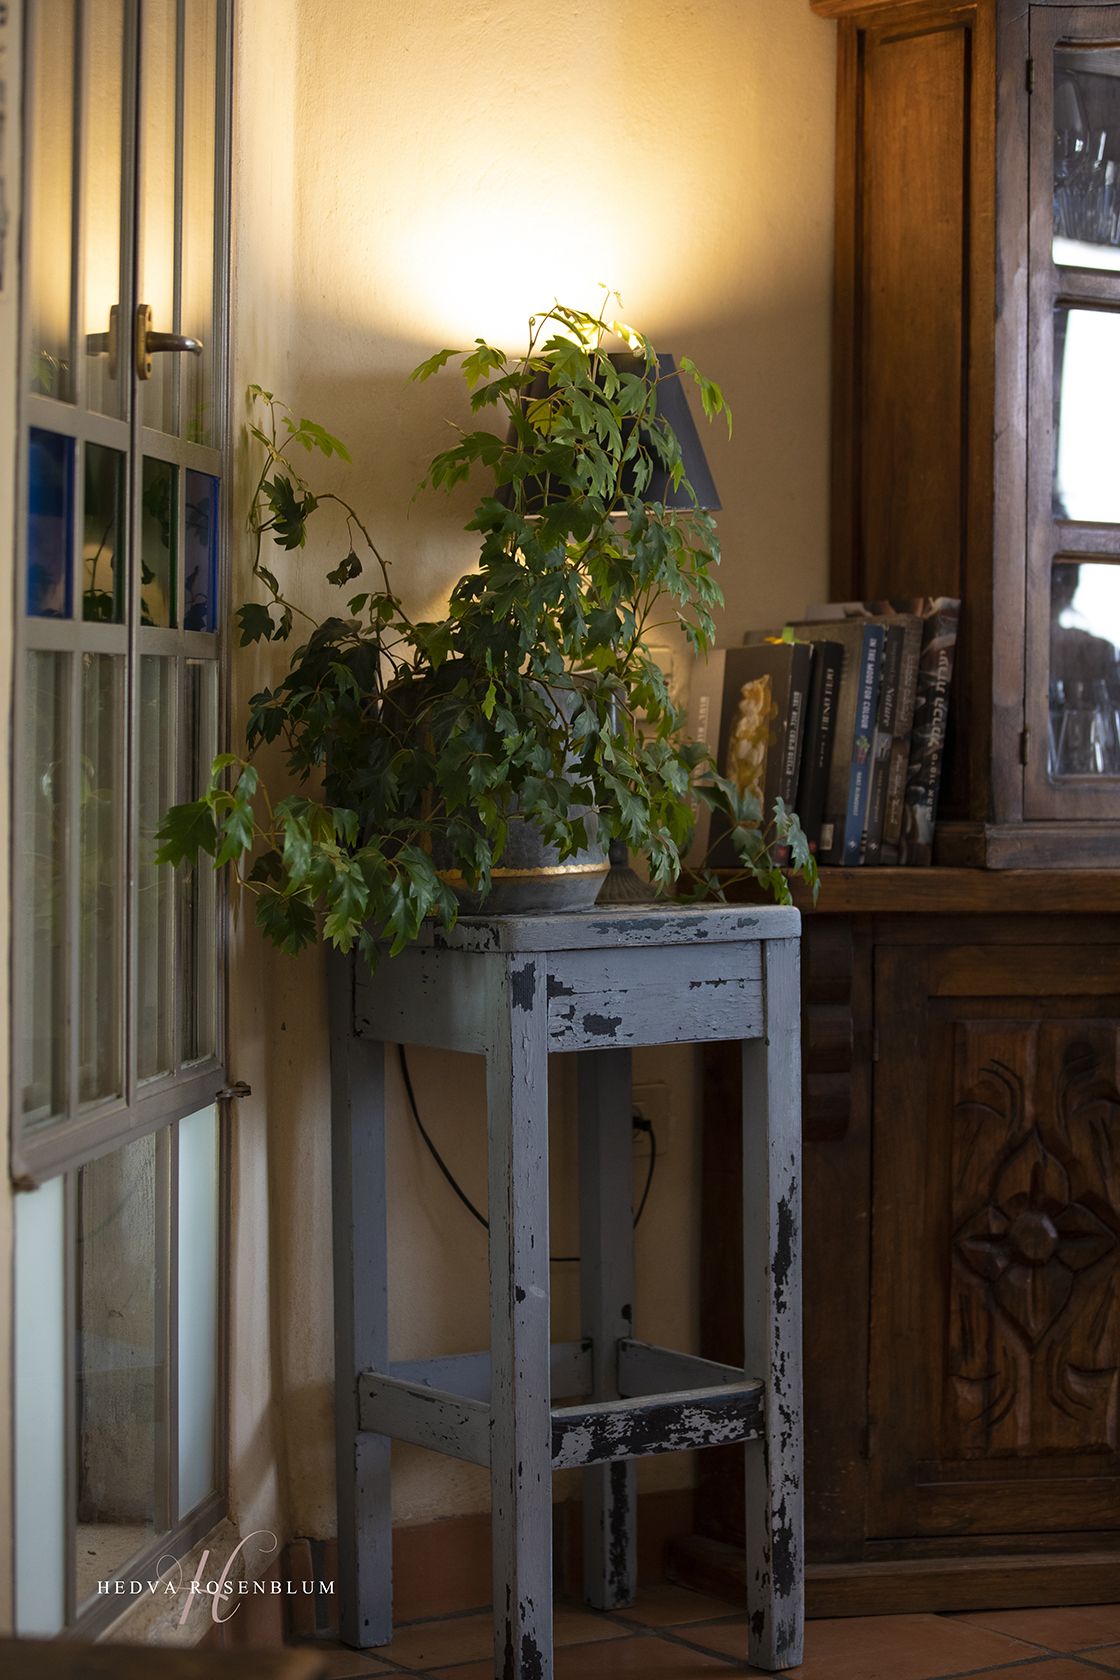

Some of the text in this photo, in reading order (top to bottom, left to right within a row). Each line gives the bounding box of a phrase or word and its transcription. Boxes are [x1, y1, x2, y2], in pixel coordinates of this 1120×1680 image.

[860, 638, 877, 729] IN THE MOOD FOR COLOUR
[934, 649, 951, 693] יערות
[881, 685, 895, 727] Nature
[928, 696, 948, 748] הכרמל
